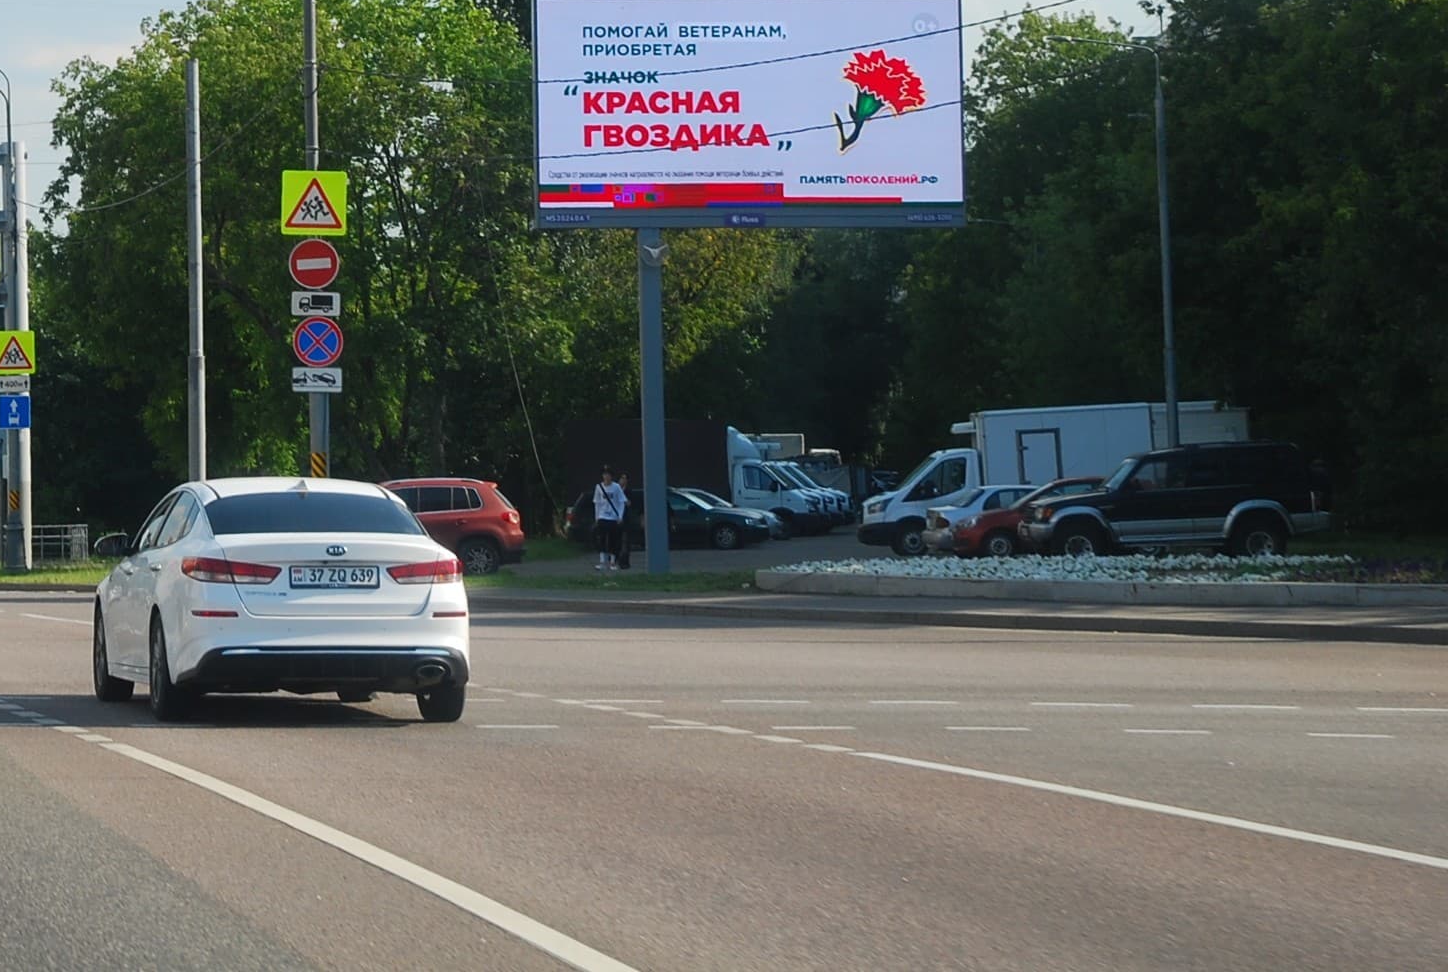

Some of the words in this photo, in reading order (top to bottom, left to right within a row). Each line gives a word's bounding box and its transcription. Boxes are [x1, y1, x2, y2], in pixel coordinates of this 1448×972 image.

[582, 23, 669, 38] ПОМОГАЙ
[678, 24, 787, 40] ВЕТЕРАНАМ,
[582, 43, 697, 57] ПРИОБРЕТАЯ
[583, 70, 659, 85] ЗНАЧОК
[799, 174, 939, 185] ПАМЯТЬПОКОЛЕНИЙ.РФ
[309, 569, 324, 583] 37
[328, 569, 347, 583] ZQ
[350, 569, 374, 582] 639
